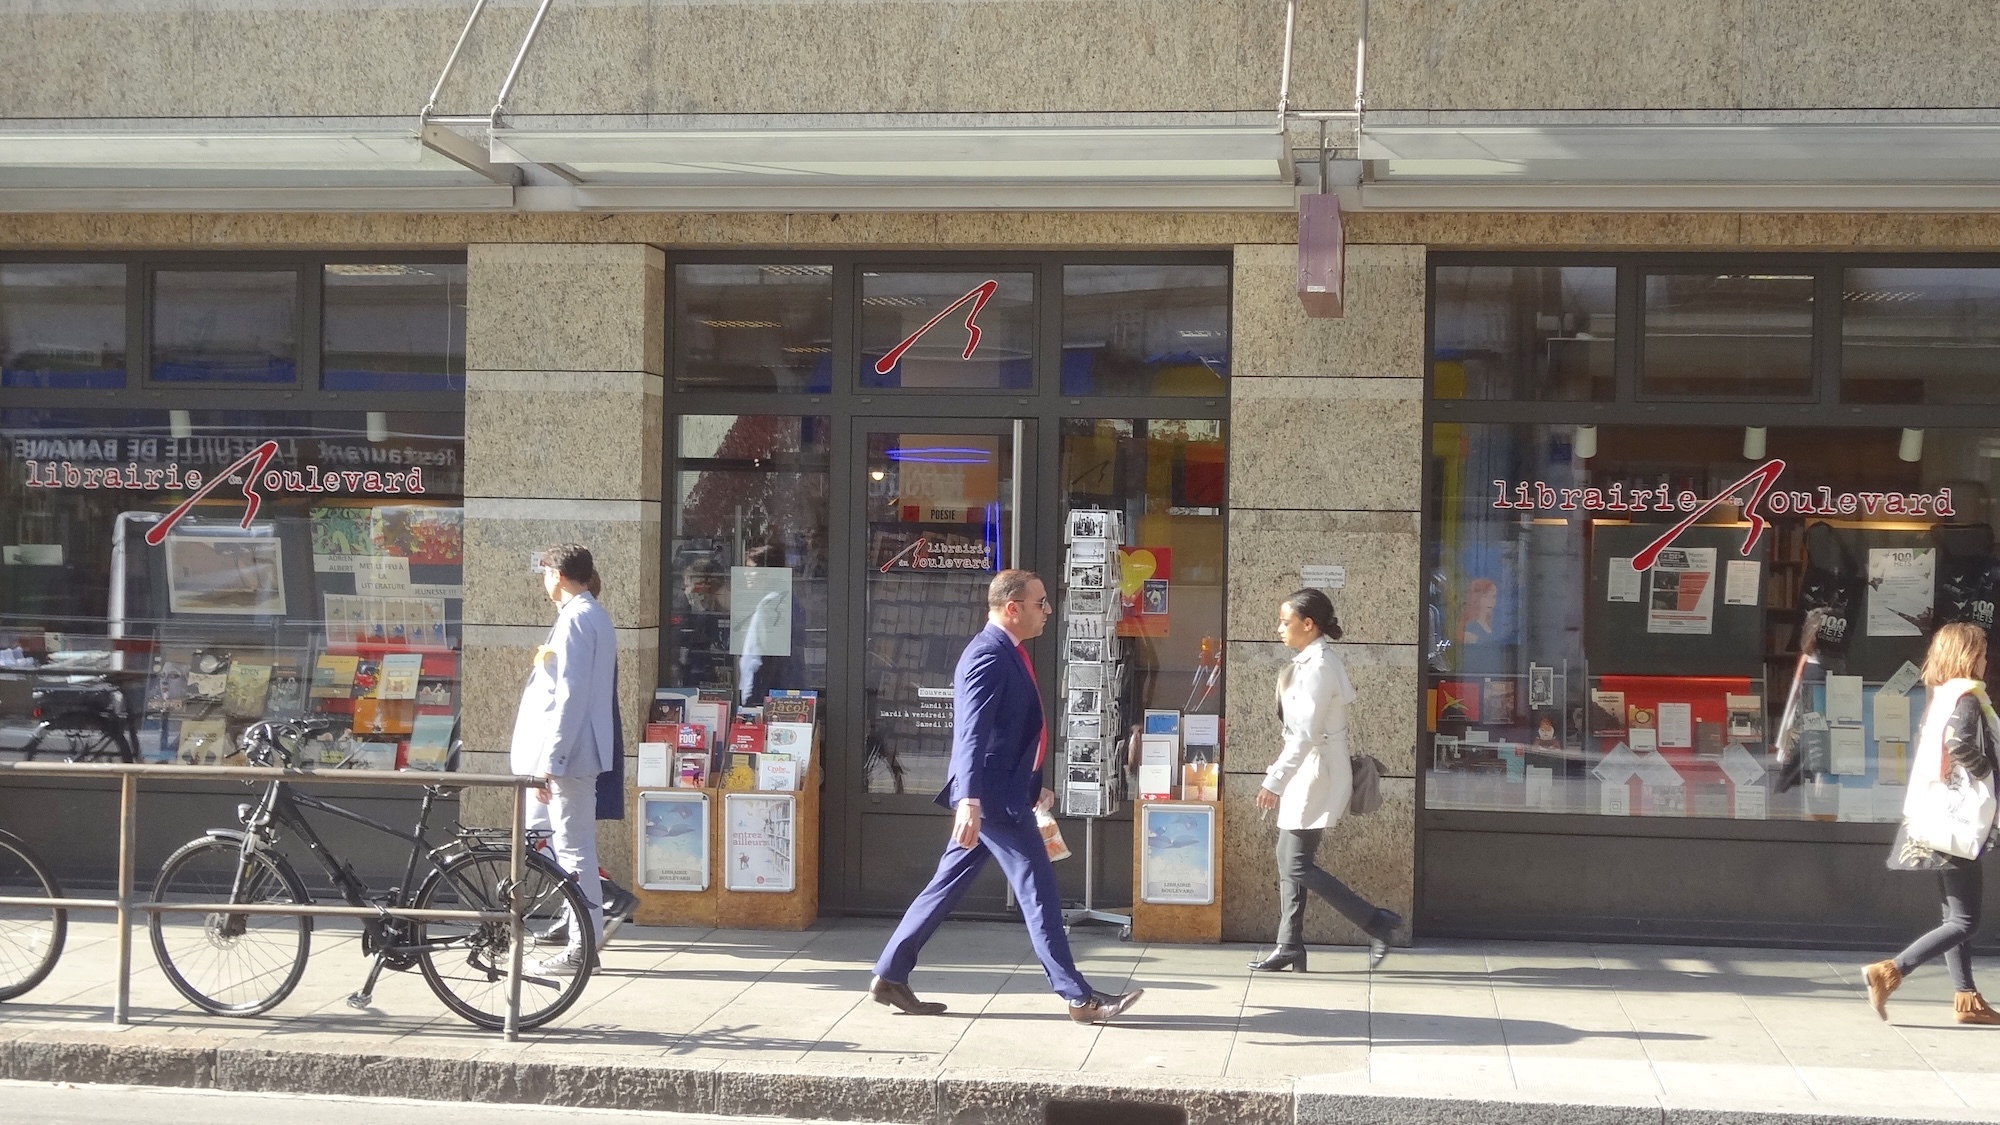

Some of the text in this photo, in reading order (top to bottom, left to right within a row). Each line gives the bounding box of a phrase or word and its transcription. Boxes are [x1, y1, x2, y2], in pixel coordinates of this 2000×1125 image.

[26, 460, 202, 489] librairie
[1493, 479, 1697, 512] librairie
[928, 542, 990, 554] librairie
[1892, 552, 1912, 562] 100
[329, 564, 353, 572] ALBERT
[414, 588, 447, 596] JEUNESSE
[1971, 600, 1995, 614] 100
[1820, 614, 1848, 629] 100
[1972, 611, 1993, 624] HETS
[1819, 626, 1844, 638] HETS
[768, 700, 810, 716] Jacob
[680, 734, 697, 744] FOOT
[732, 831, 762, 839] entrez
[732, 838, 769, 846] ailleurs
